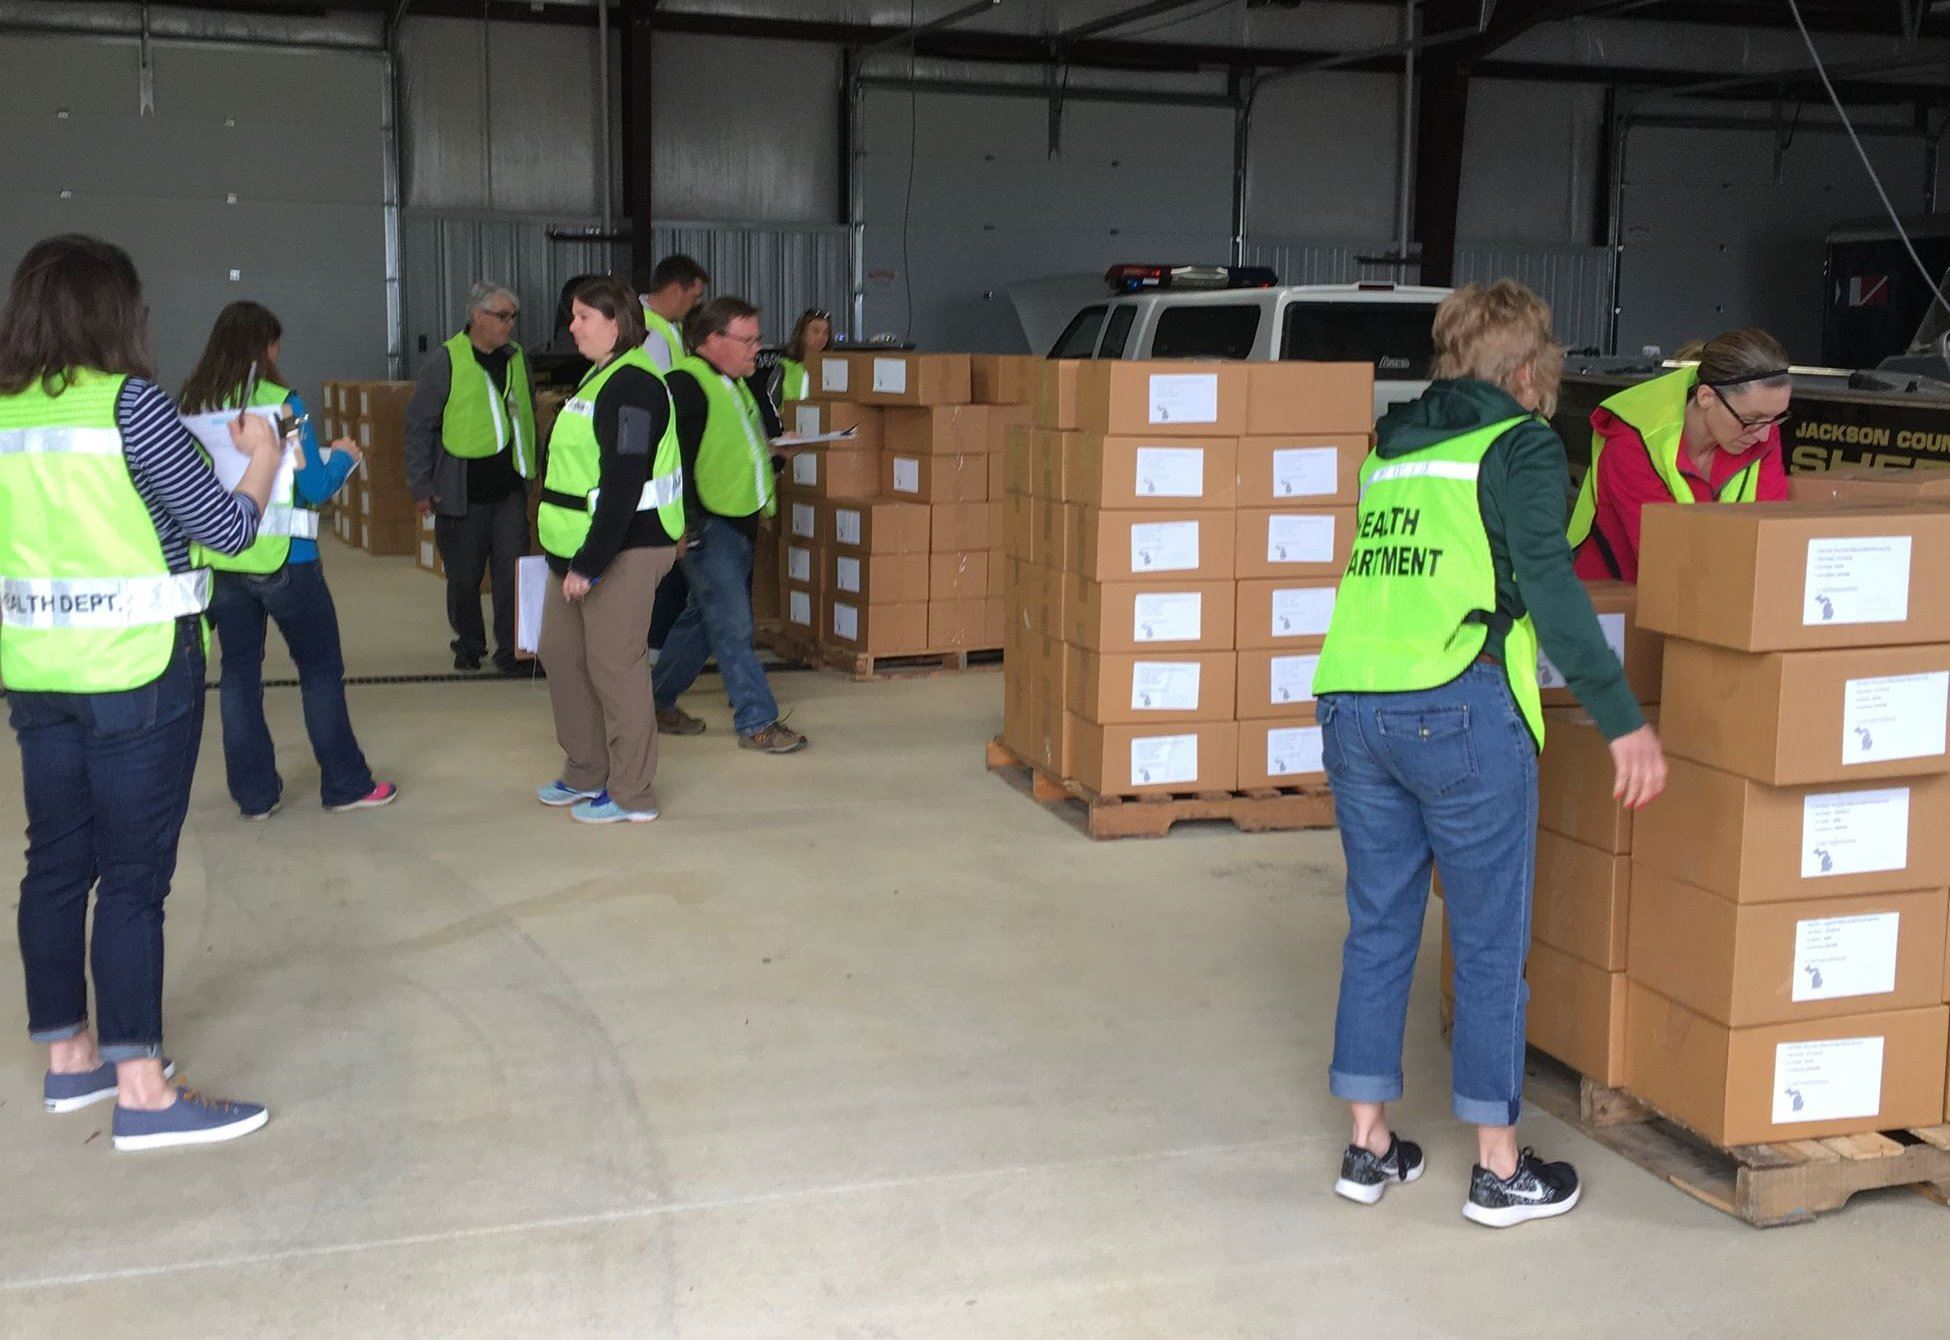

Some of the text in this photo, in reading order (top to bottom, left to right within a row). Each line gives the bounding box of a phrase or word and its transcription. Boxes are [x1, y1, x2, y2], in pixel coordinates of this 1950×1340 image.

[1796, 422, 1890, 447] JACKSON
[1358, 507, 1420, 538] EALTH
[60, 592, 122, 613] DEPT.
